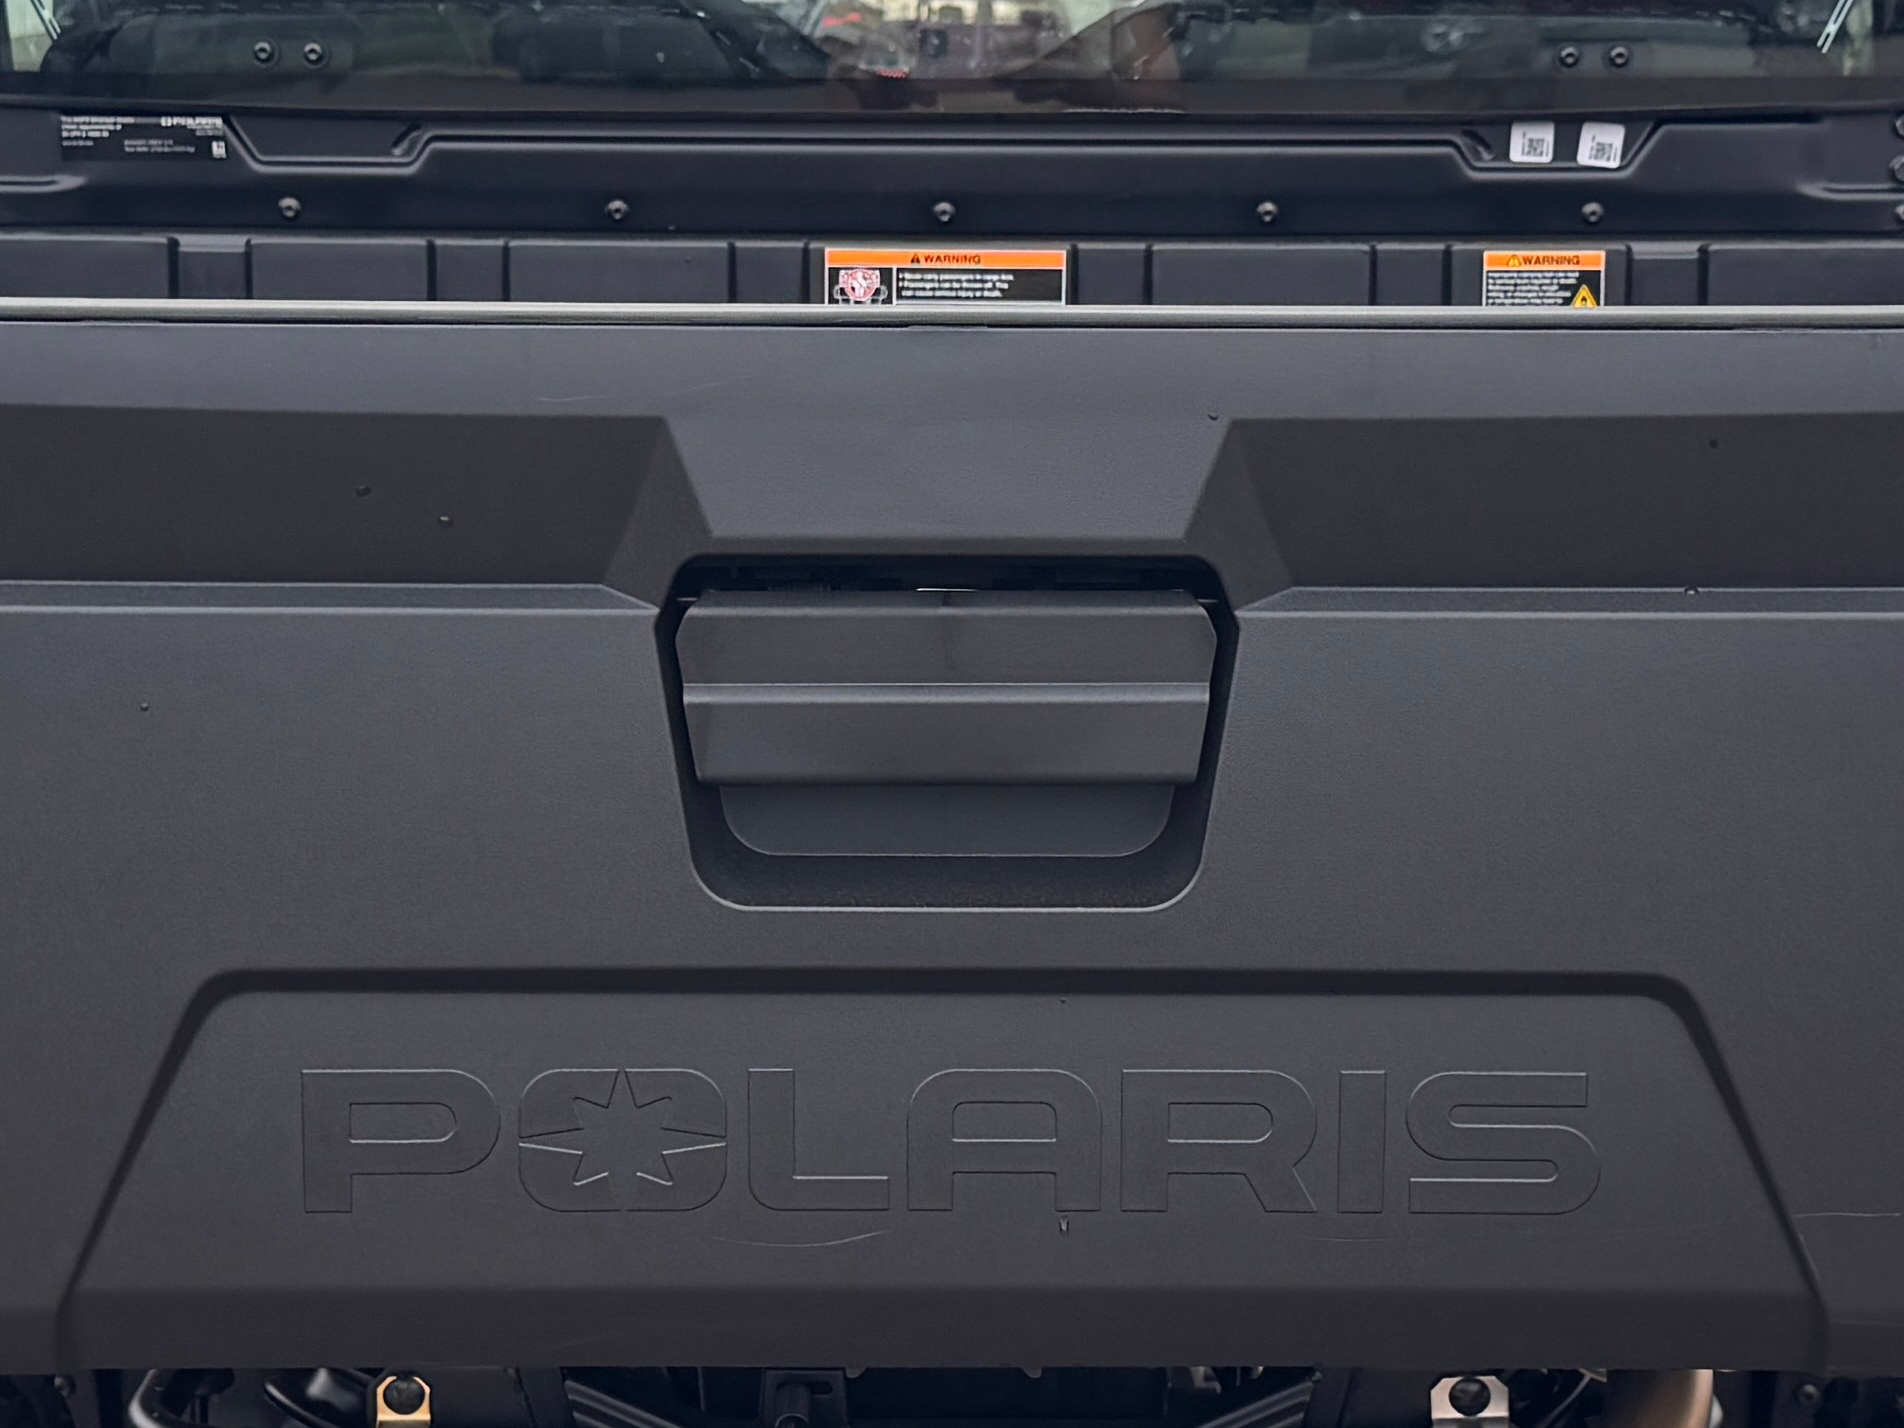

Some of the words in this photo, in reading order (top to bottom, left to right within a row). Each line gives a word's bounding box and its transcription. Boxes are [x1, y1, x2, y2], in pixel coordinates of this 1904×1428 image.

[924, 254, 981, 264] WARNING
[1522, 255, 1581, 265] WARNING
[301, 1068, 1602, 1216] POLARIS
